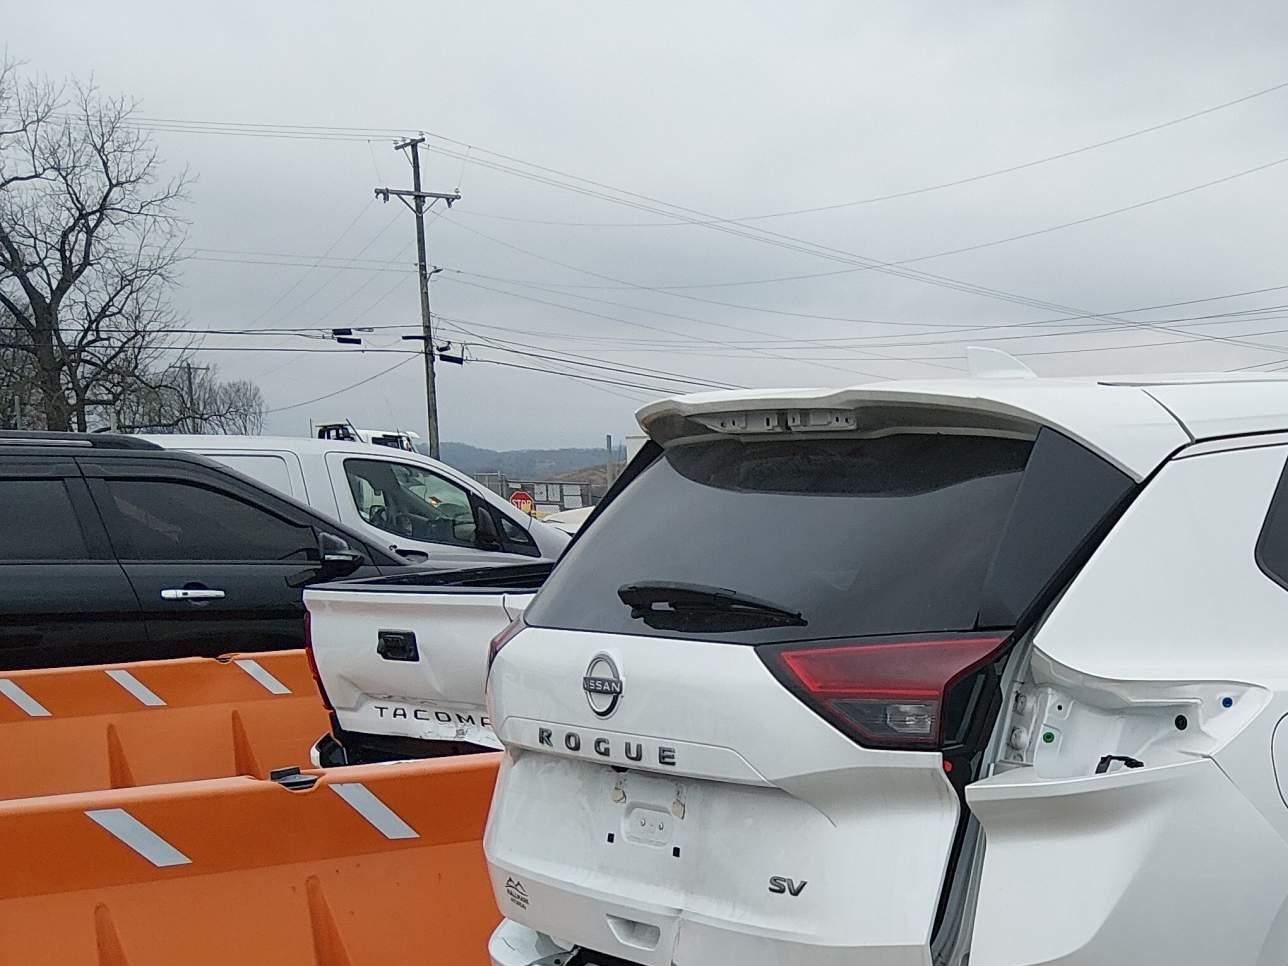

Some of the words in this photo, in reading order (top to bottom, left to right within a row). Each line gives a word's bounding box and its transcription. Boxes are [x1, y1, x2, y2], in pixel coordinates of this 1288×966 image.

[511, 500, 532, 511] STOP
[538, 727, 676, 766] ROGUE
[768, 876, 808, 896] SV
